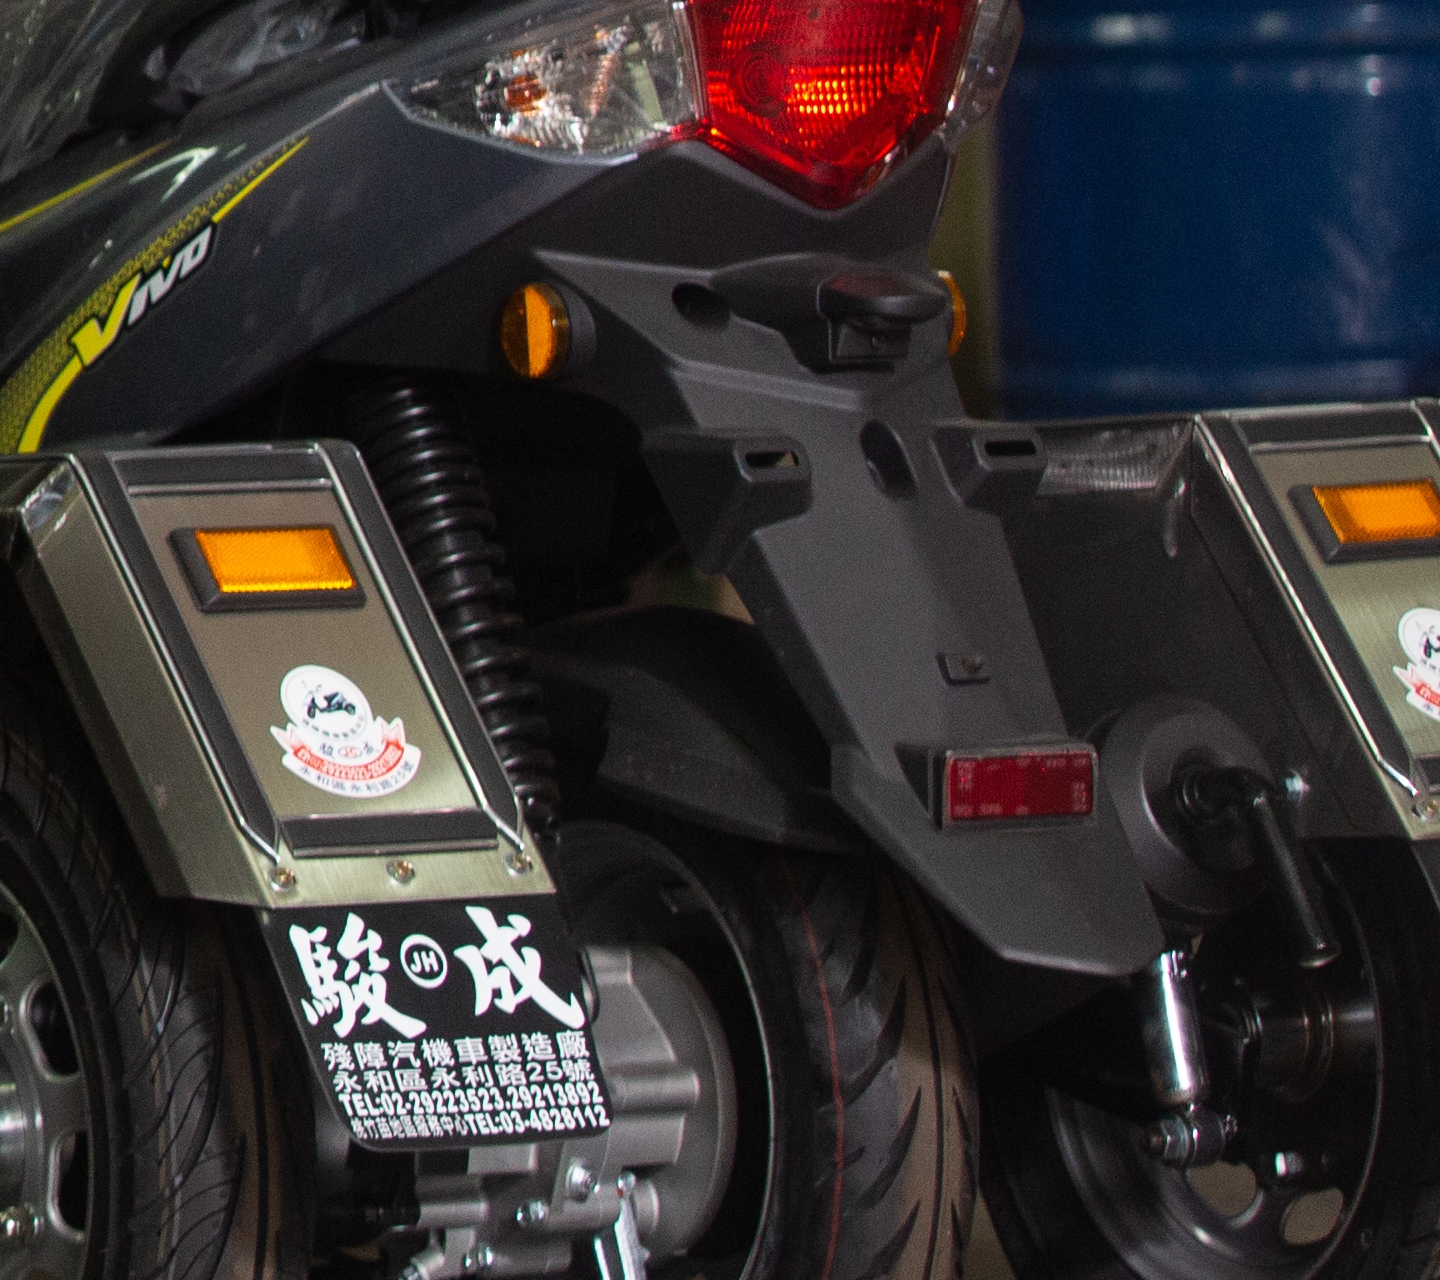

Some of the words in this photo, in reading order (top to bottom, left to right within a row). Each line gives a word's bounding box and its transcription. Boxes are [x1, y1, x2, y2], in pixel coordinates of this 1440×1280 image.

[409, 950, 439, 973] JH
[321, 1030, 589, 1071] 殘障汽機車製造廠
[332, 1059, 595, 1093] 永和區永利路25號
